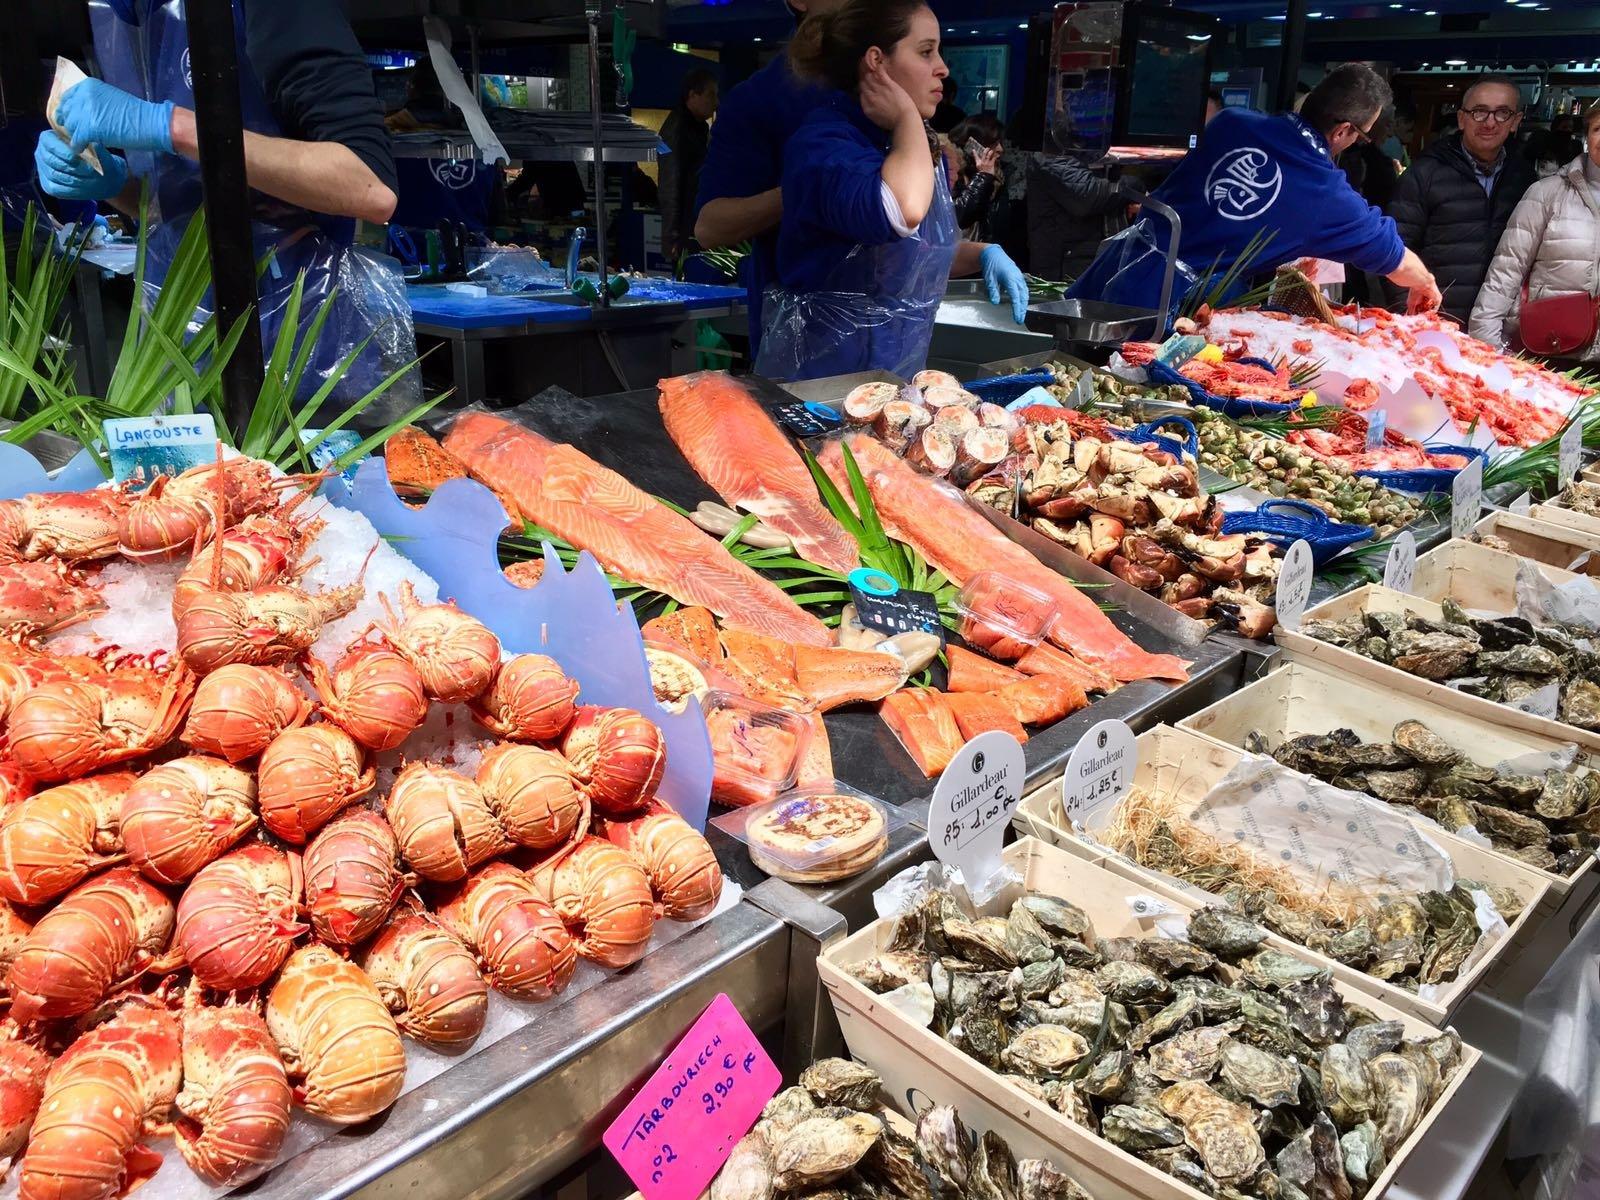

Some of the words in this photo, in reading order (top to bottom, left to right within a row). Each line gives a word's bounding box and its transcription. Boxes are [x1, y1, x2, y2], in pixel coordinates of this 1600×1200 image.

[115, 426, 203, 442] LANGOUSTE
[1080, 748, 1123, 778] Gillardeau
[950, 766, 1007, 813] Gillardeau
[621, 1034, 722, 1151] TARBOURIECH
[702, 1076, 734, 1115] 2,90
